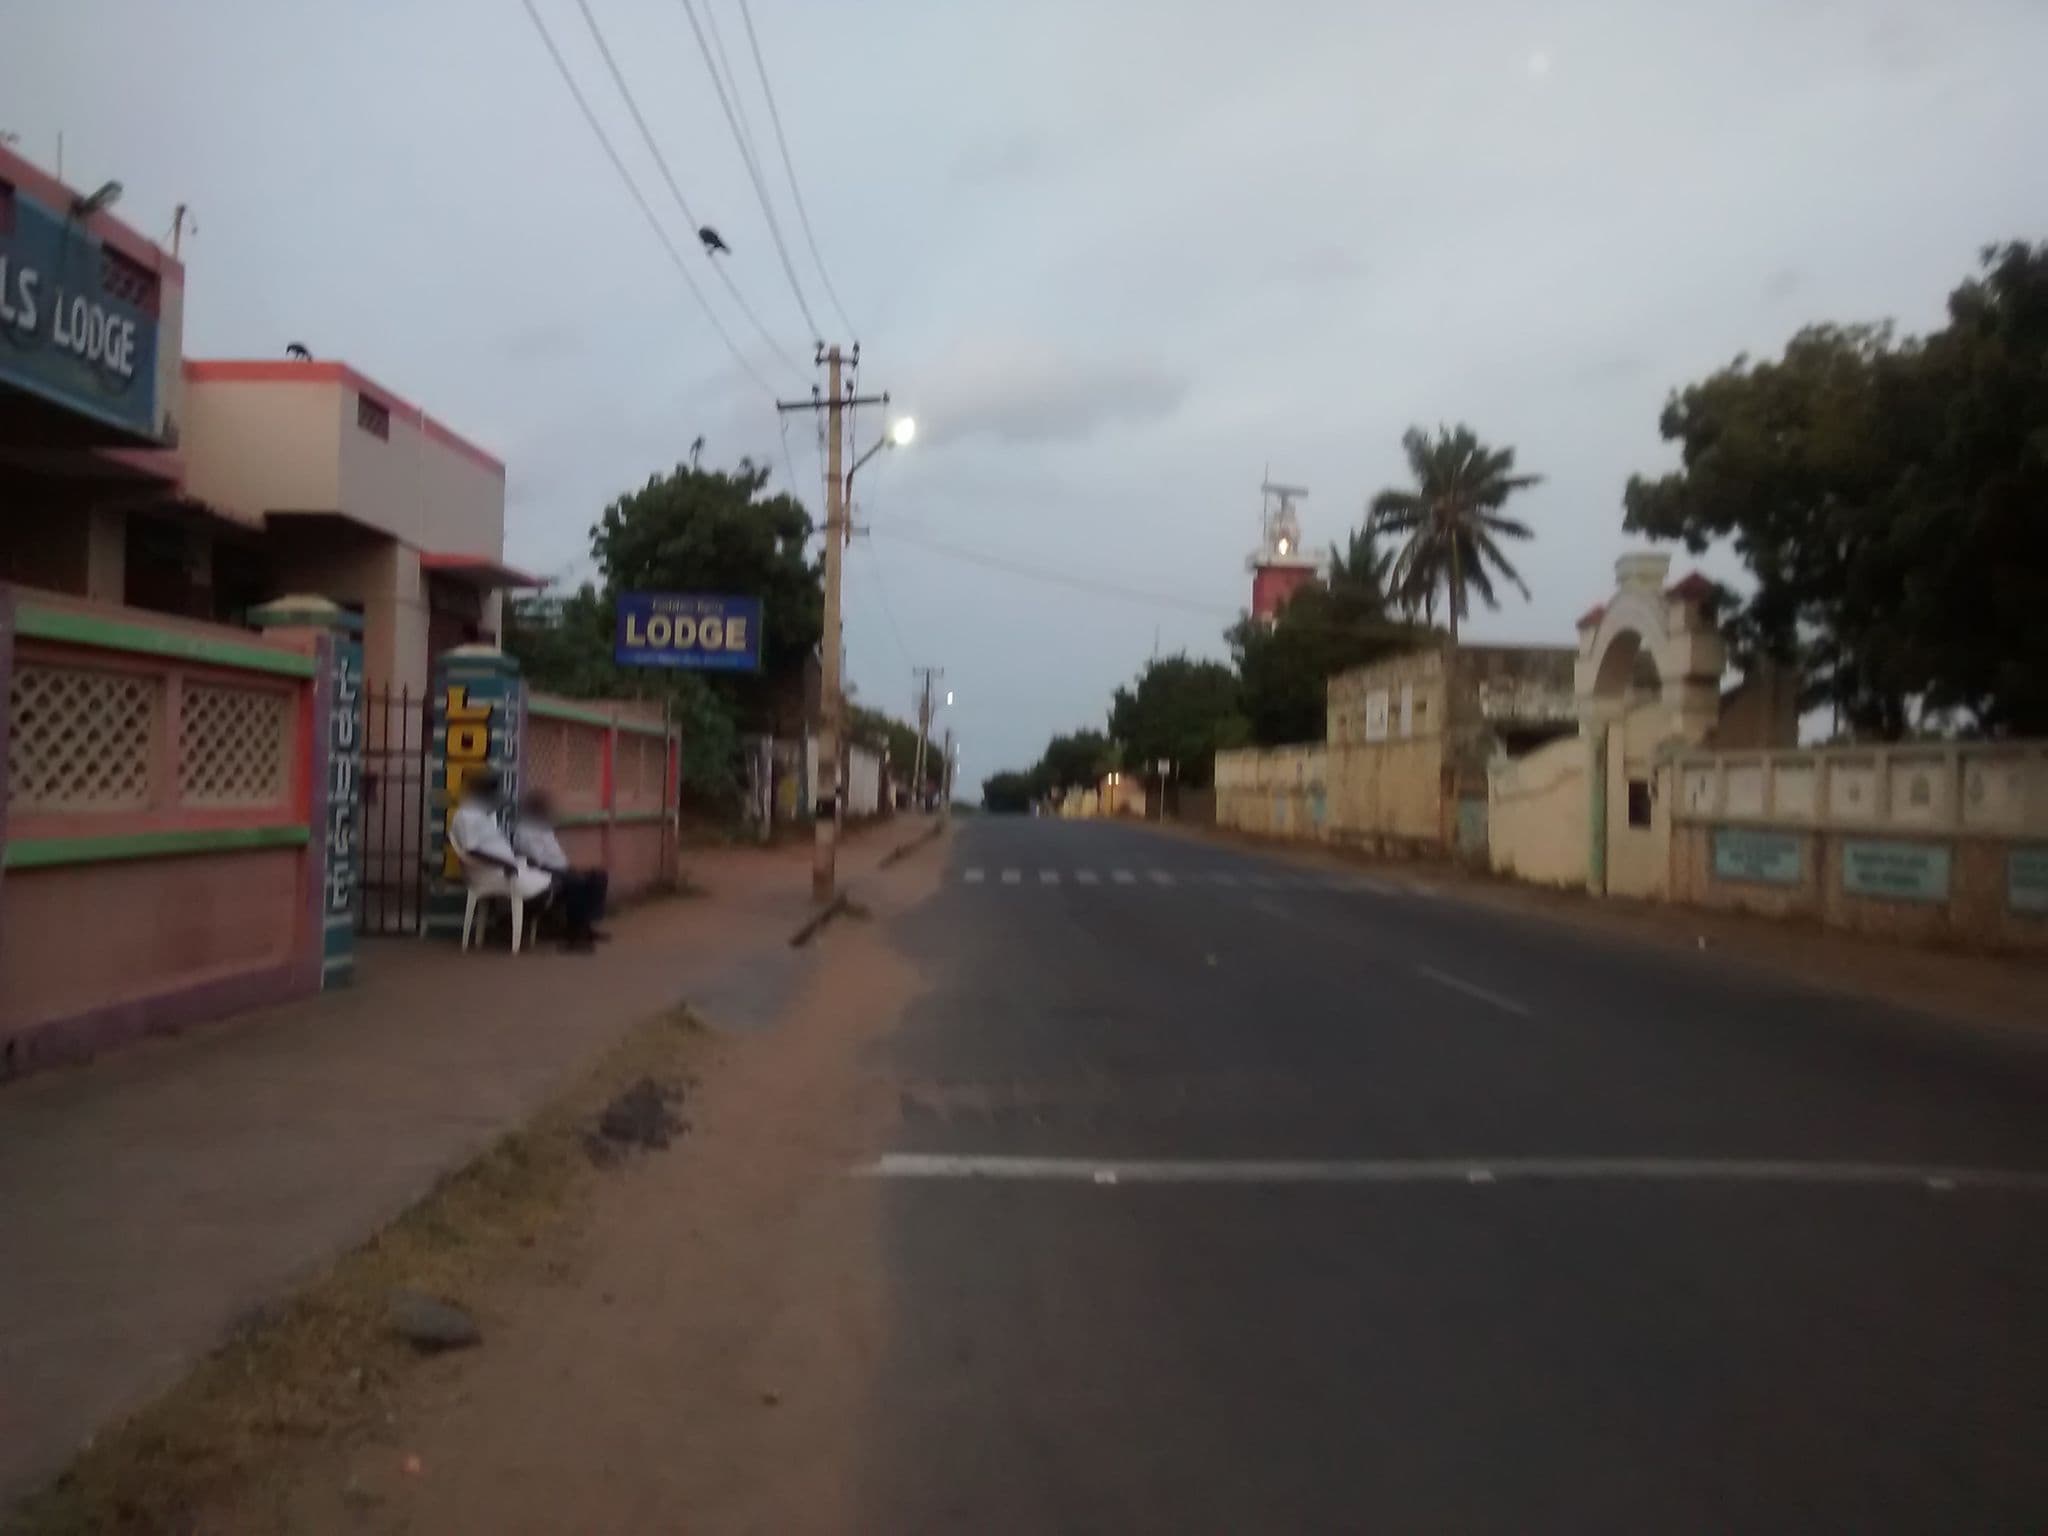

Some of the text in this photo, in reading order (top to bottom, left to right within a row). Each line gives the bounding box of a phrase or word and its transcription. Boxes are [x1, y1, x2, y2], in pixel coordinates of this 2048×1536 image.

[54, 287, 135, 377] LODGE
[626, 613, 747, 650] LODGE
[331, 657, 357, 907] LODGE
